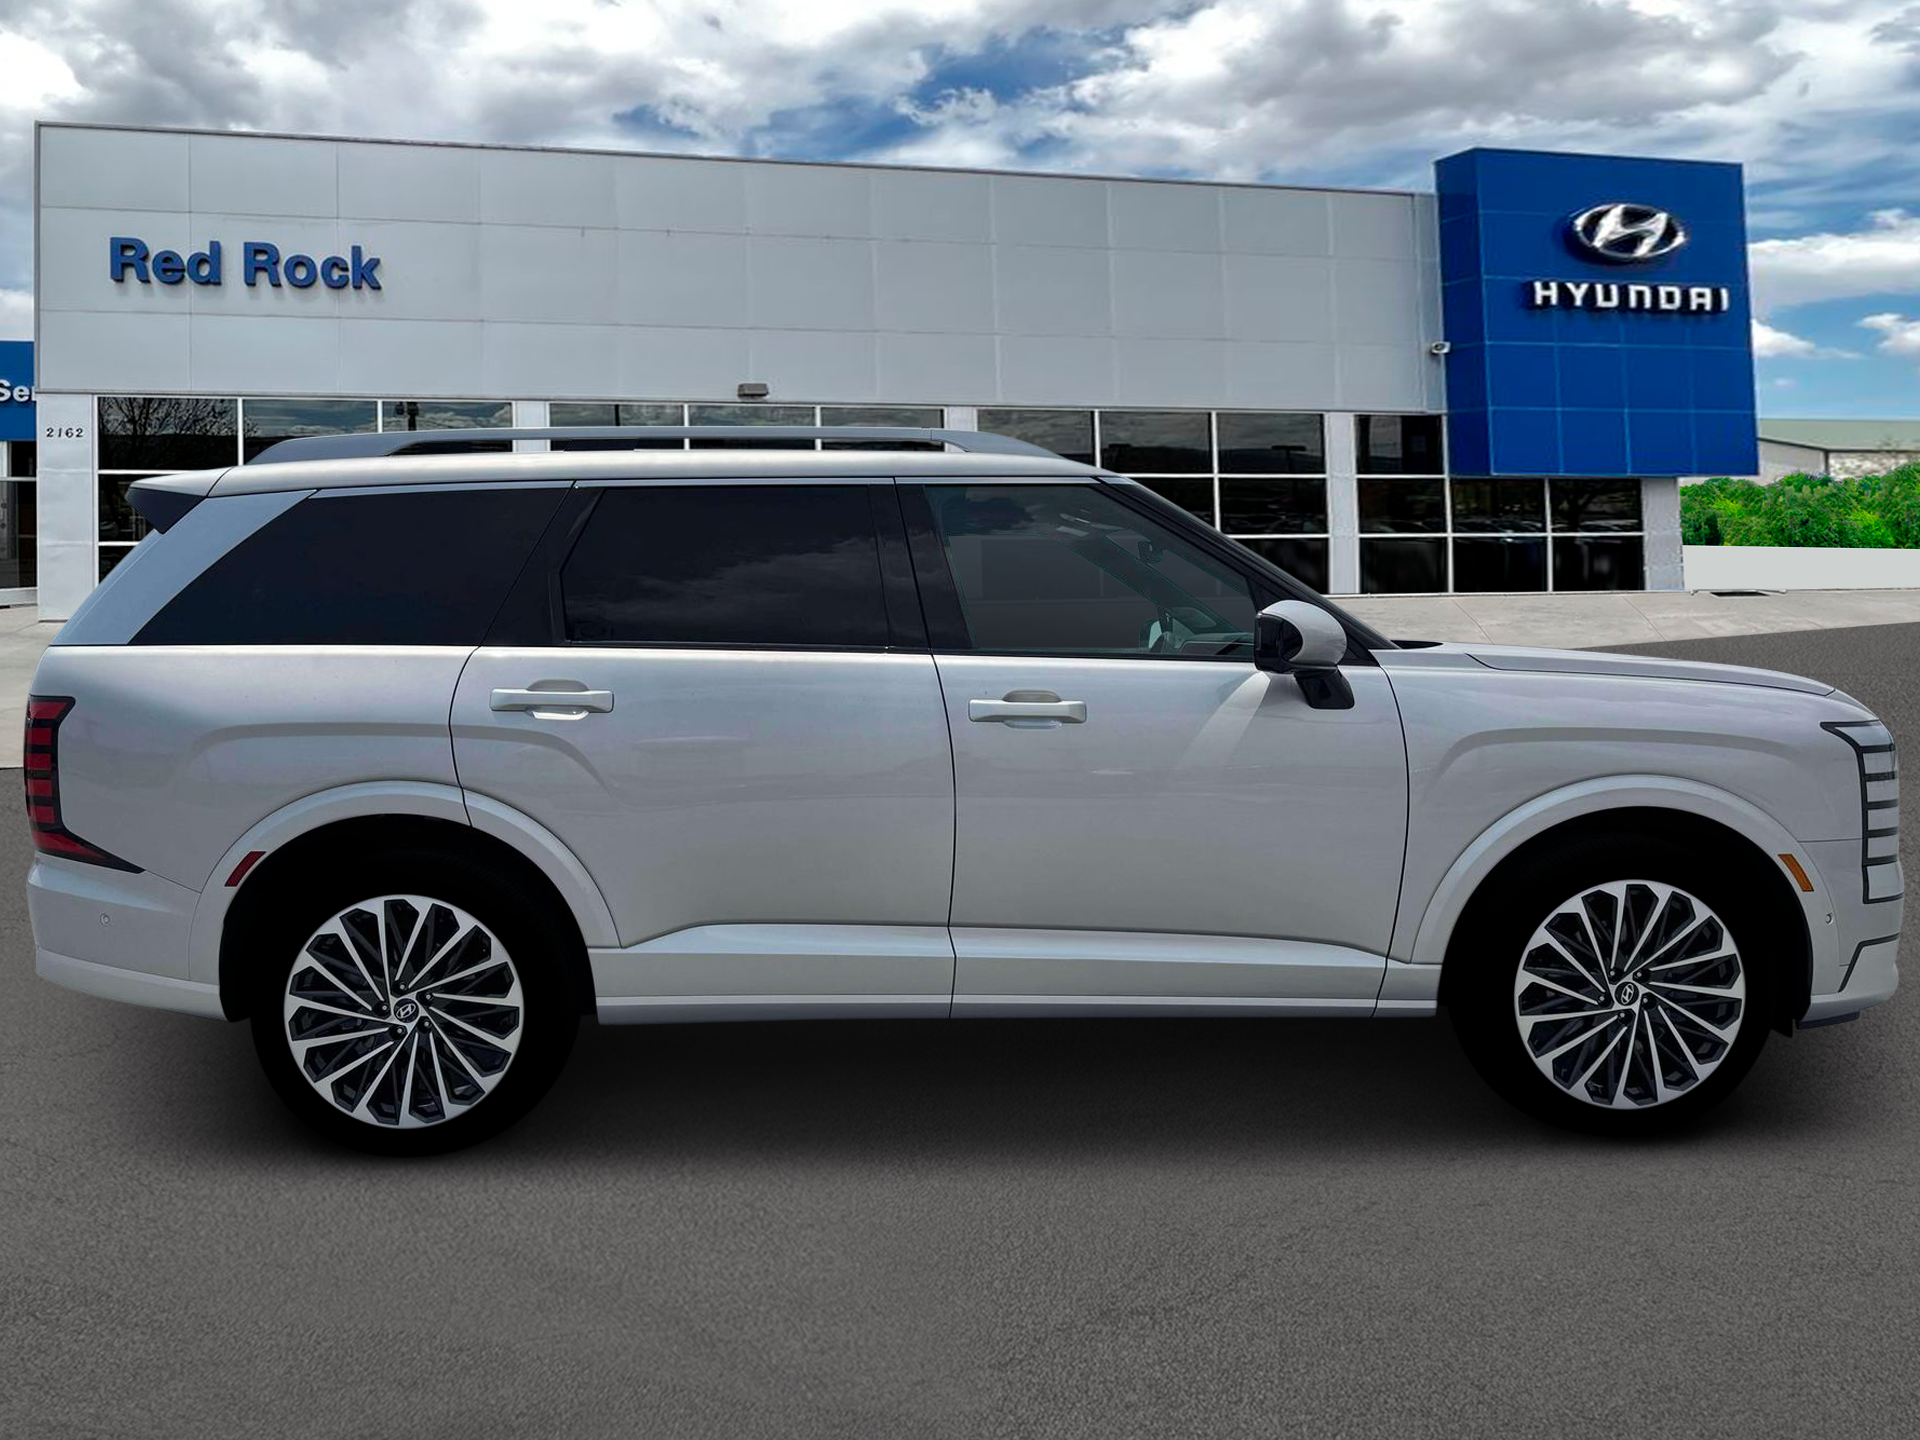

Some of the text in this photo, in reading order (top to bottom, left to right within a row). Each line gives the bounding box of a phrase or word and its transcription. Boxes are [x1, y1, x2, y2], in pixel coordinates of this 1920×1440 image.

[110, 237, 382, 290] Red Rock
[1534, 281, 1729, 311] HYUNDAI
[46, 427, 84, 438] 2162
